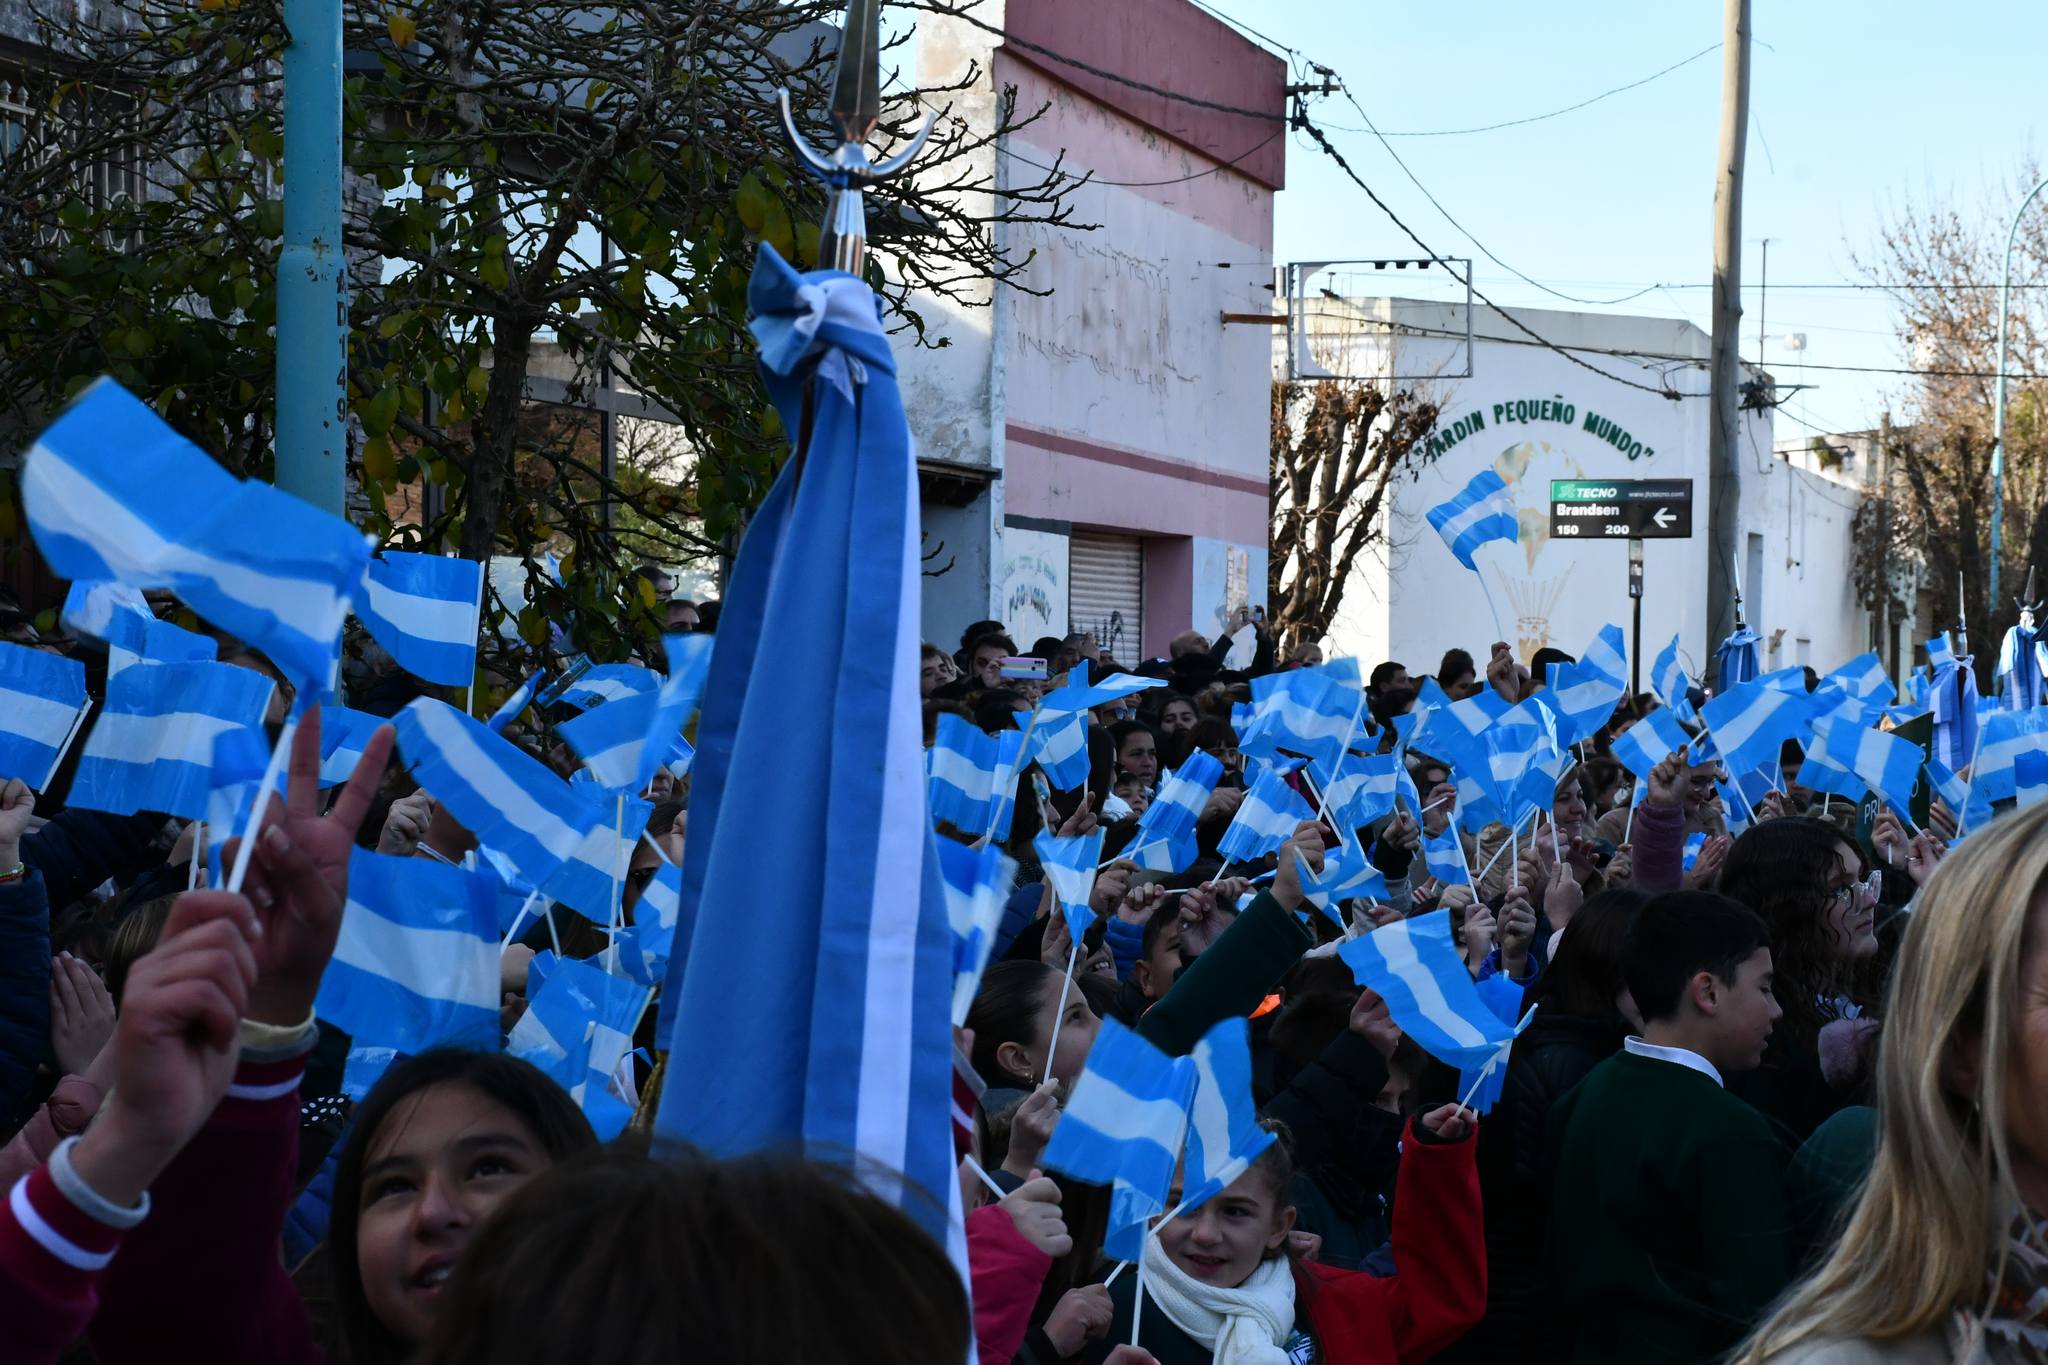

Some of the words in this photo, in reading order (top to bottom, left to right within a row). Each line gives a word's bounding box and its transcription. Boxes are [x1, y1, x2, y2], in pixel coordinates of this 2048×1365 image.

[1493, 394, 1575, 425] PEQUEÑO
[1583, 411, 1655, 462] MUNDO"
[1576, 487, 1618, 499] TECNO
[1556, 503, 1620, 516] Brandsen
[1556, 524, 1579, 535] 150
[1605, 524, 1630, 535] 200
